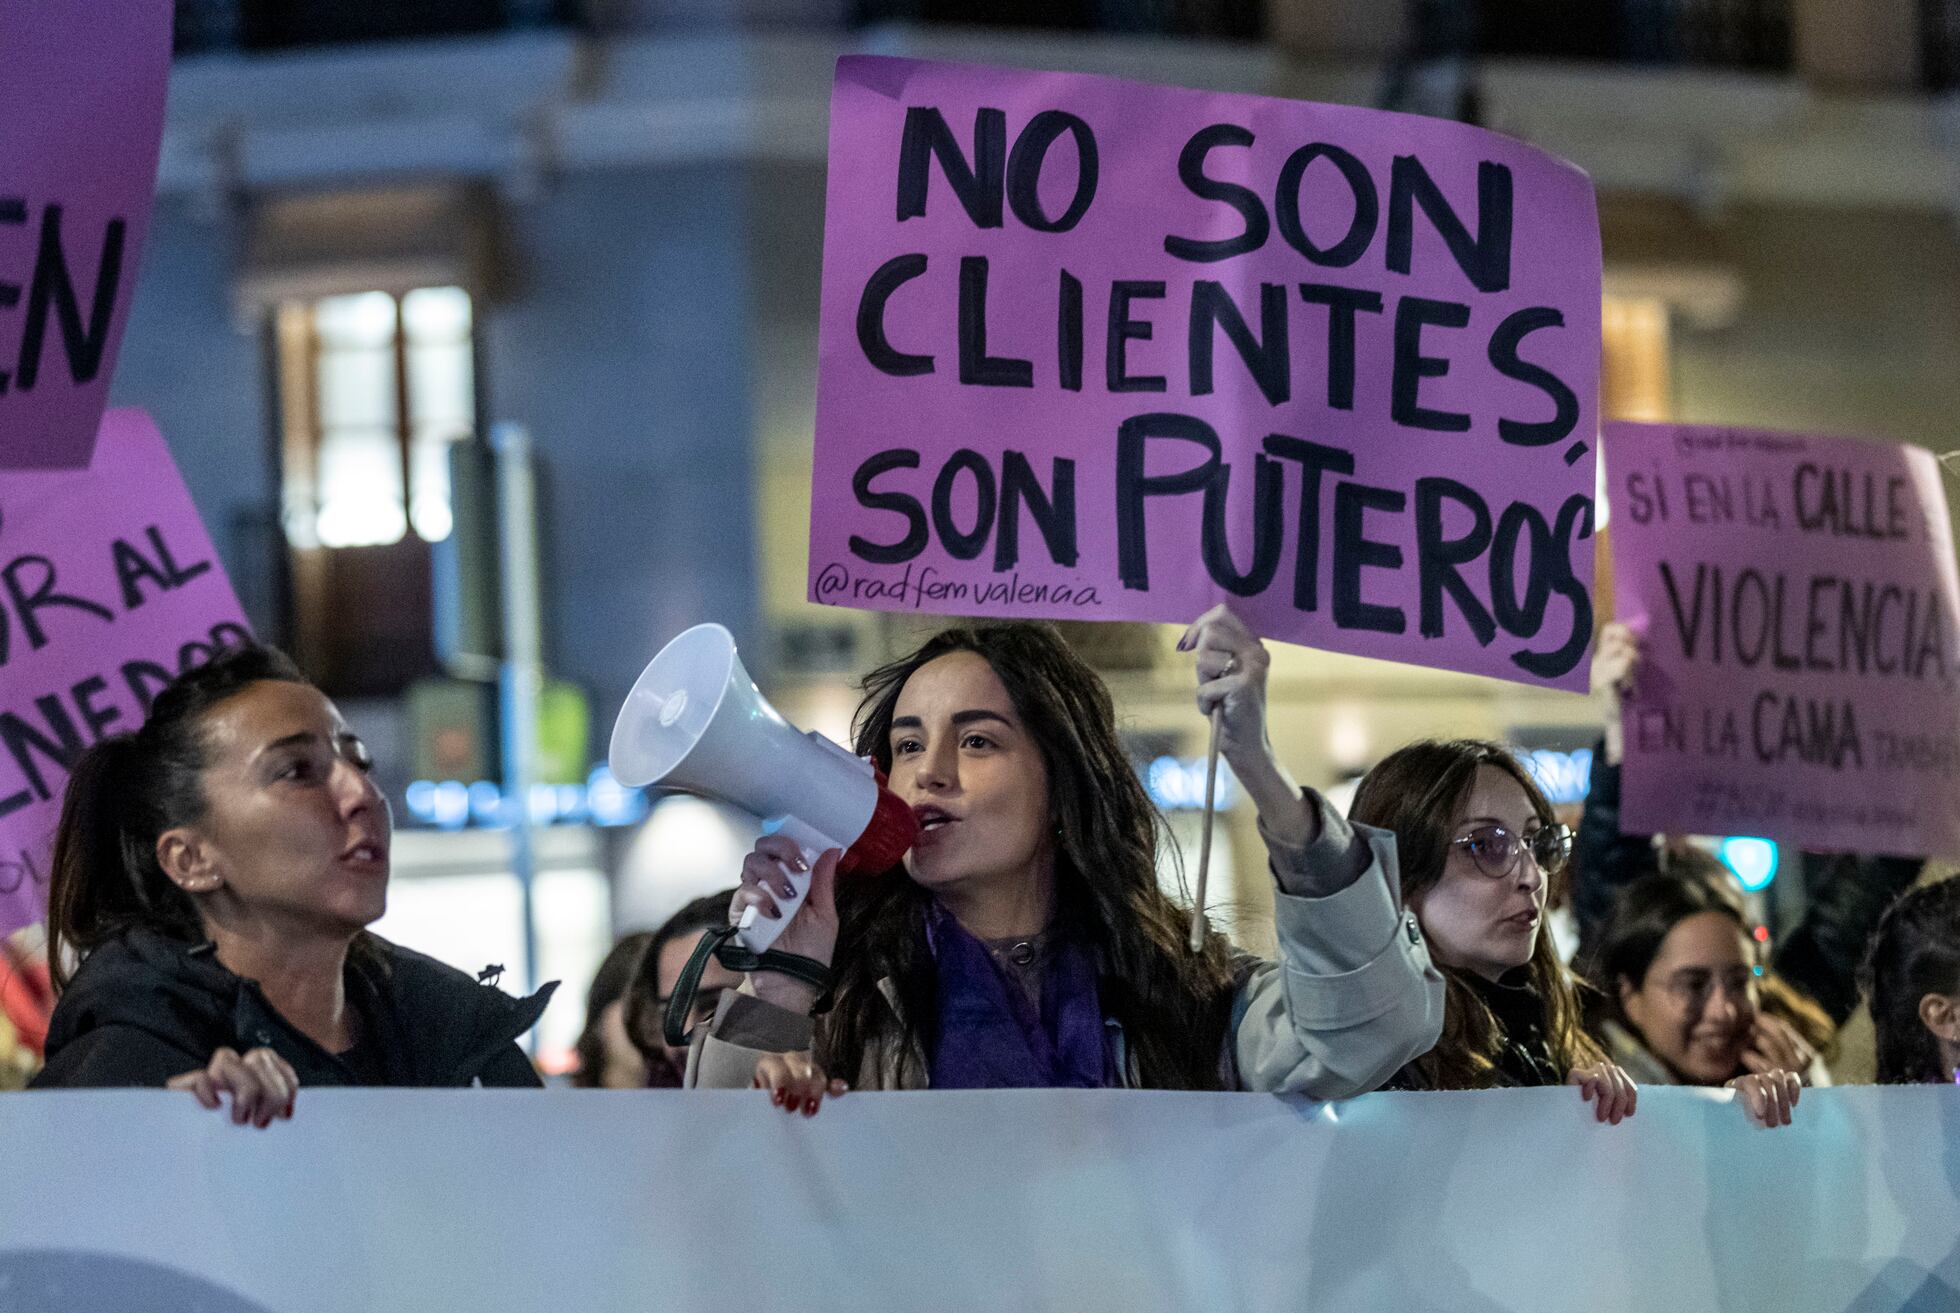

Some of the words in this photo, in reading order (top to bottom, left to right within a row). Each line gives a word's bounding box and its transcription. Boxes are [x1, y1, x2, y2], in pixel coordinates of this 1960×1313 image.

[896, 106, 1099, 233] NO
[1164, 123, 1513, 292] SON
[1684, 472, 1734, 524] EN
[1793, 462, 1909, 540] CALLE
[111, 525, 211, 610] AL
[849, 448, 1080, 572] SON
[1116, 412, 1595, 678] PUTEROS
[1752, 690, 1863, 771] CAMA
